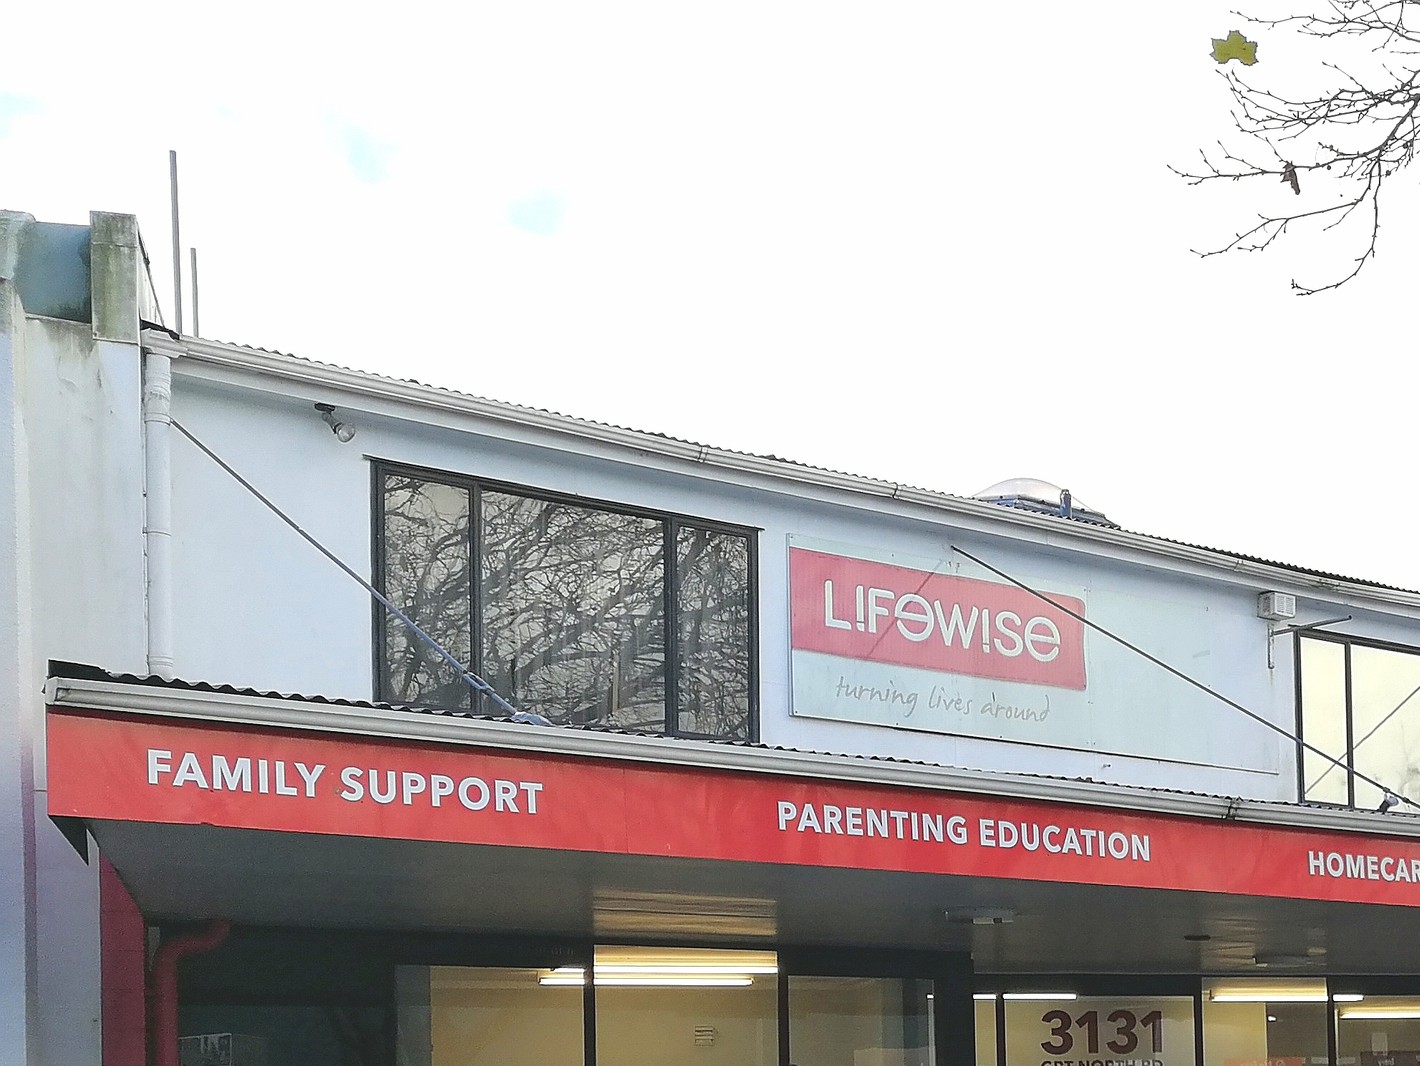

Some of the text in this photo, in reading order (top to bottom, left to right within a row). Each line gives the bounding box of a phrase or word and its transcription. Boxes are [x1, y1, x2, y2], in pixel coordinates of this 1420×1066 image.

[836, 676, 1051, 723] turning lives around
[146, 748, 543, 815] FAMILY SUPPORT
[777, 801, 1151, 862] PARENTING EDUCATION
[1040, 1009, 1164, 1056] 3131
